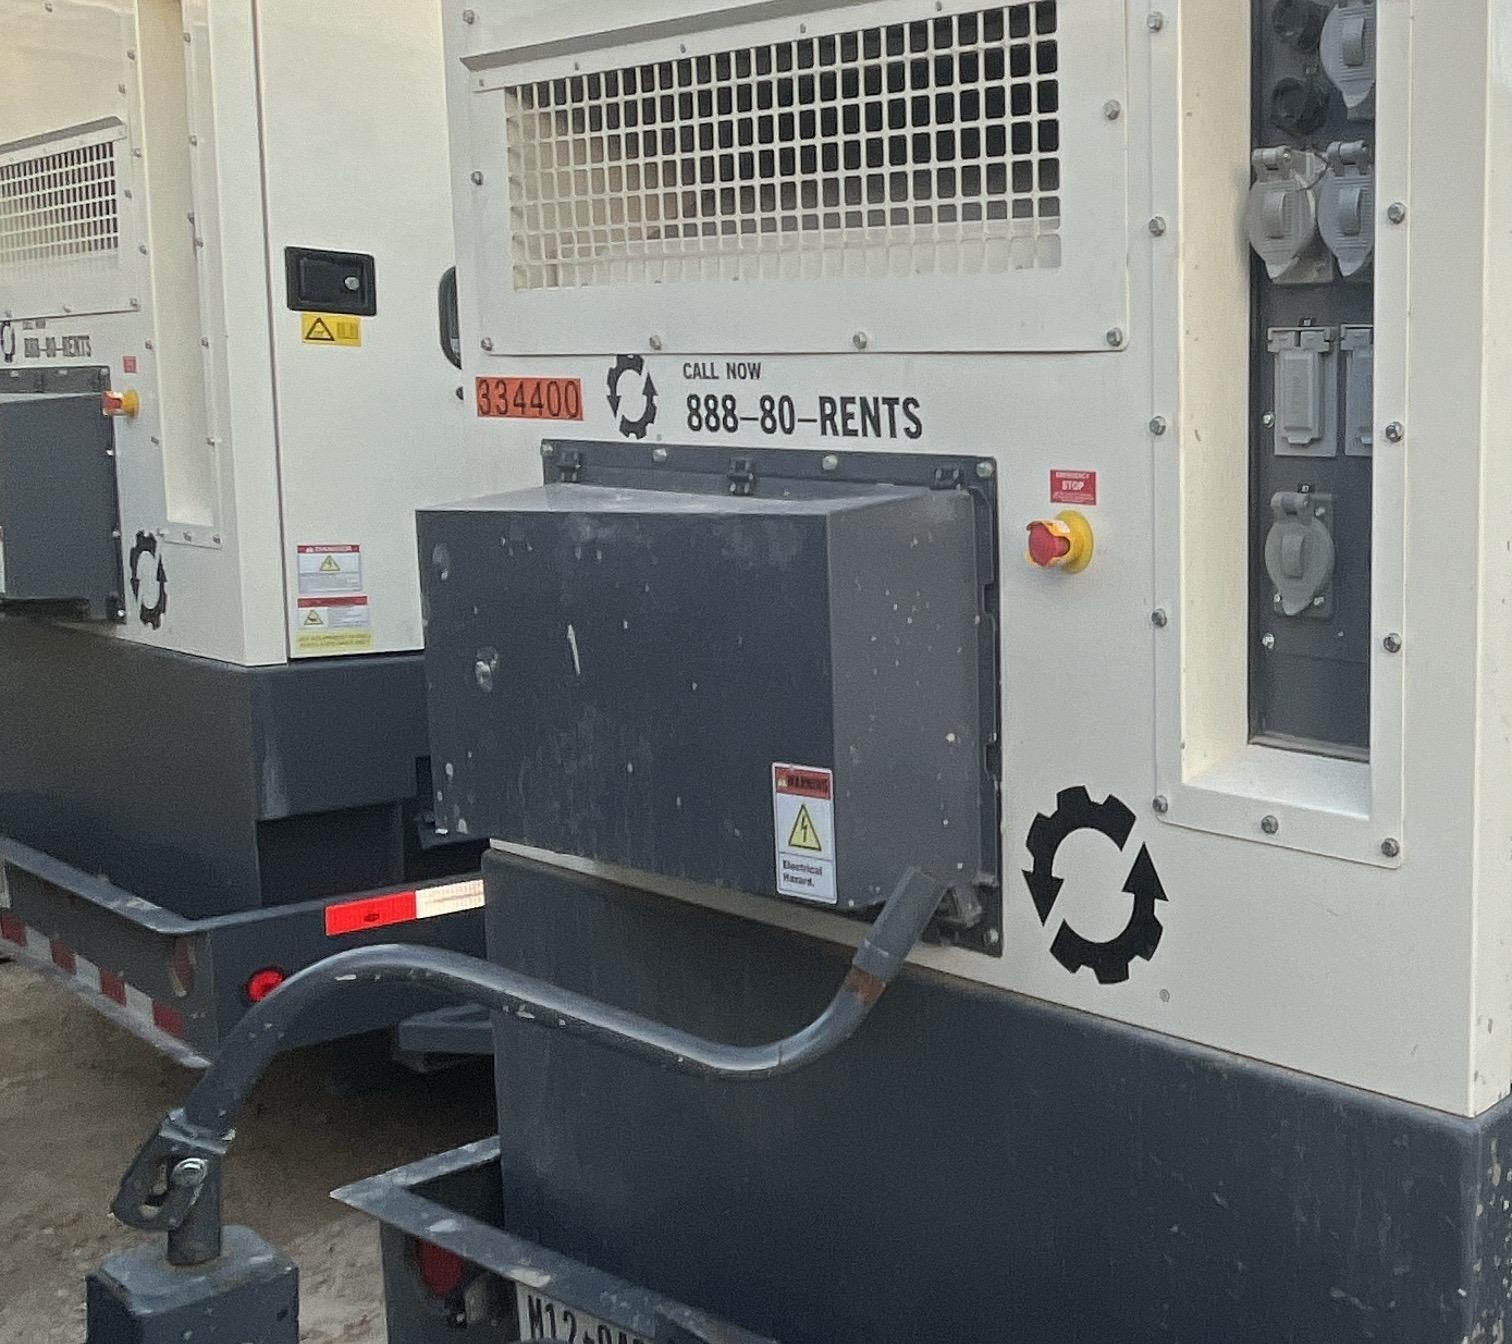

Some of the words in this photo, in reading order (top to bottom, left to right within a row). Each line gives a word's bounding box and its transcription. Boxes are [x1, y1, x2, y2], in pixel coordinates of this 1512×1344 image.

[682, 362, 719, 380] CALL
[726, 362, 762, 380] NOW
[477, 379, 579, 419] 334400
[686, 393, 923, 439] 888-80-RENTS
[1062, 480, 1085, 491] STOP
[782, 859, 823, 876] Electrical
